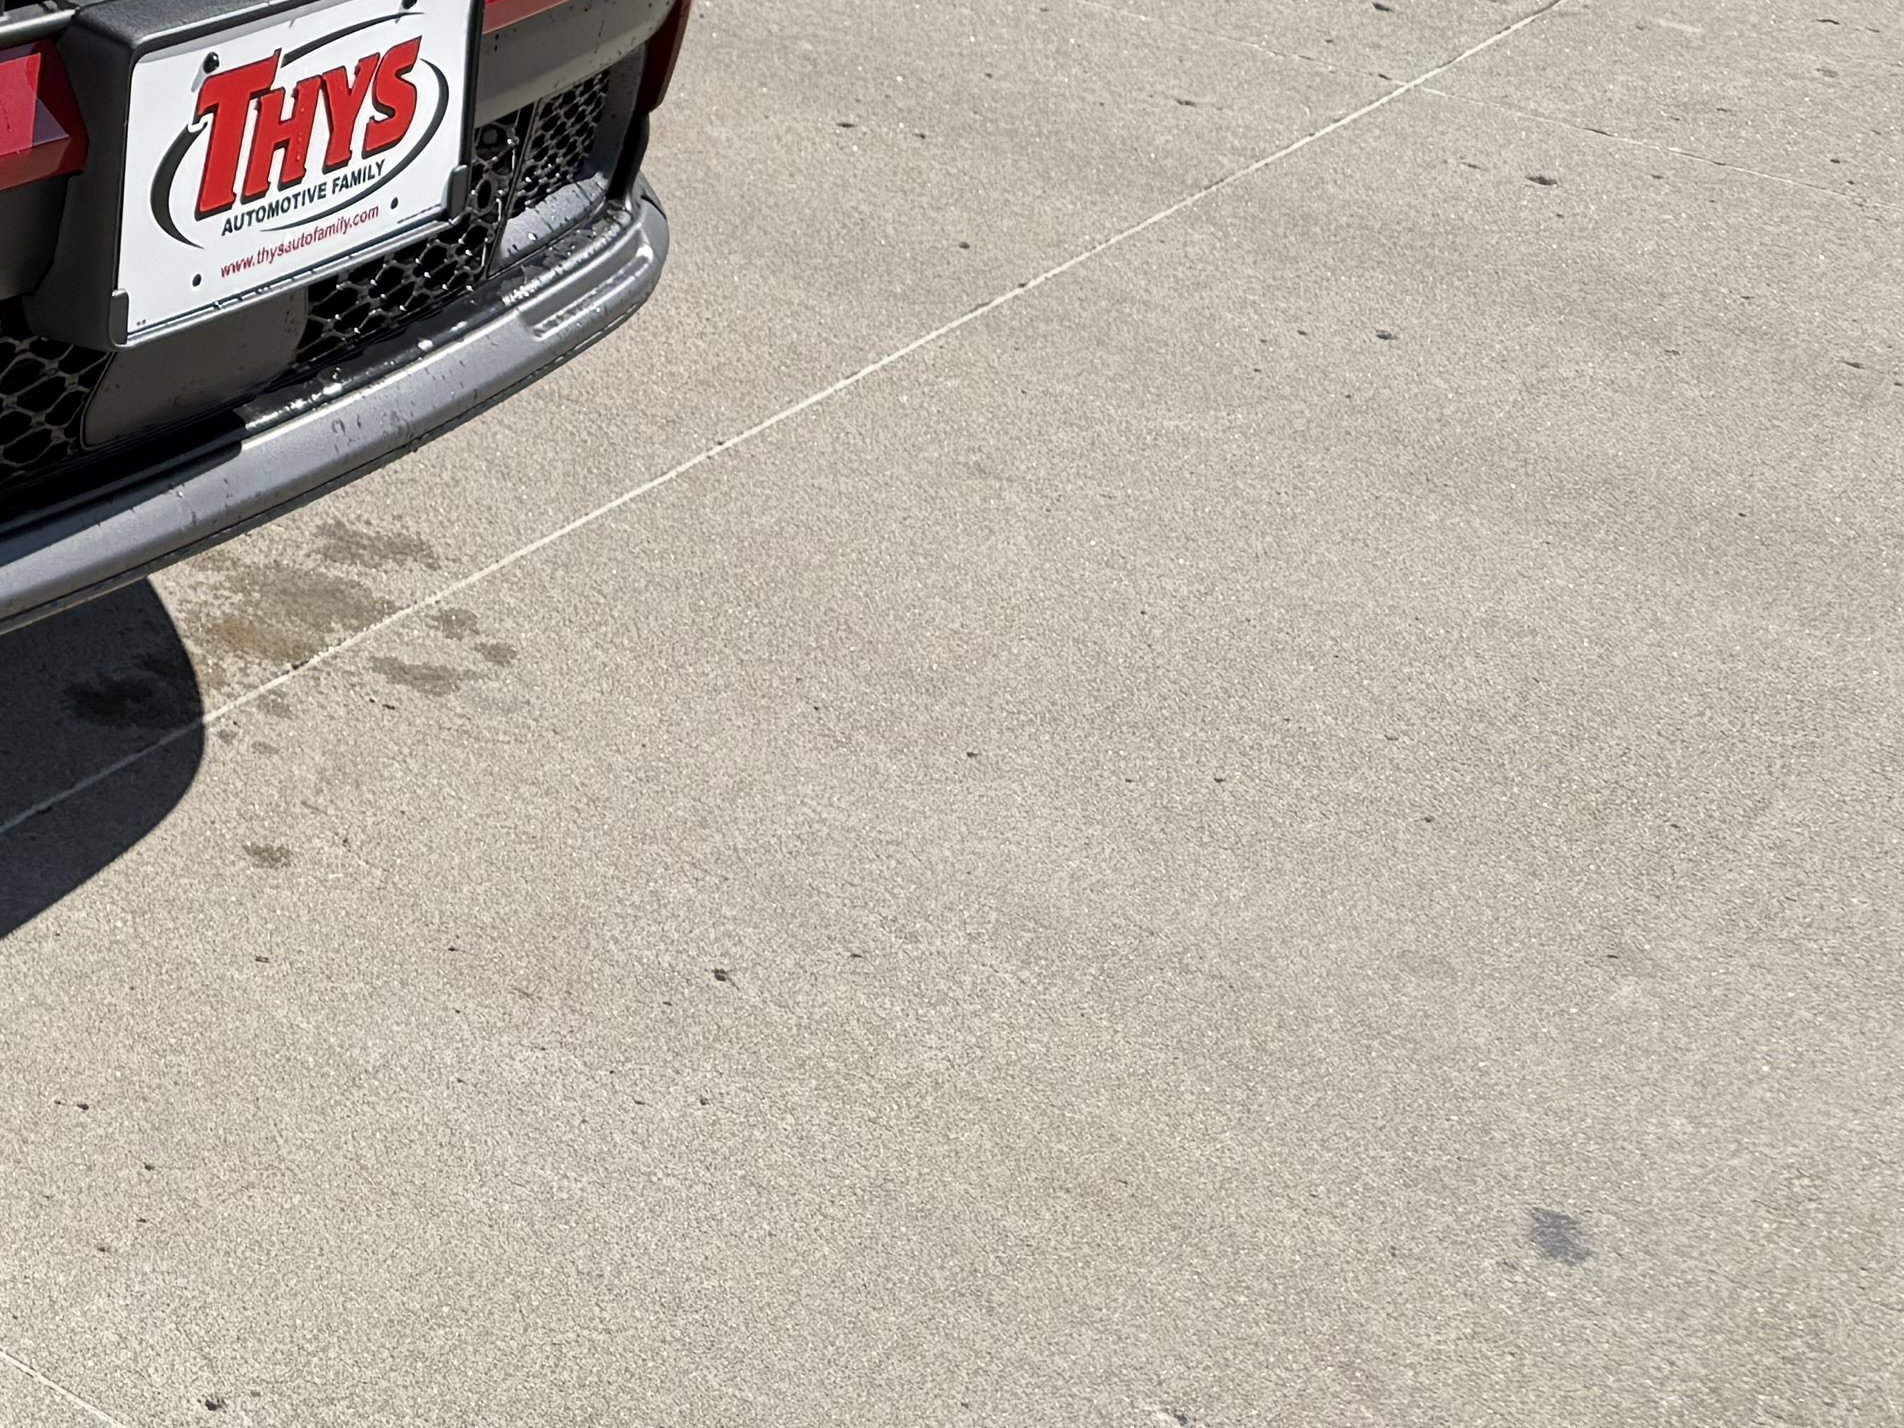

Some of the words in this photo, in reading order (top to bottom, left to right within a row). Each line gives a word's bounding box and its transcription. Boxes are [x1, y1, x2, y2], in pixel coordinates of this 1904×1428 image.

[194, 36, 422, 221] THYS
[221, 182, 327, 237] AUTOMOTIVE
[330, 158, 386, 203] FAMILY
[219, 204, 380, 280] www.thysautofamily.com
